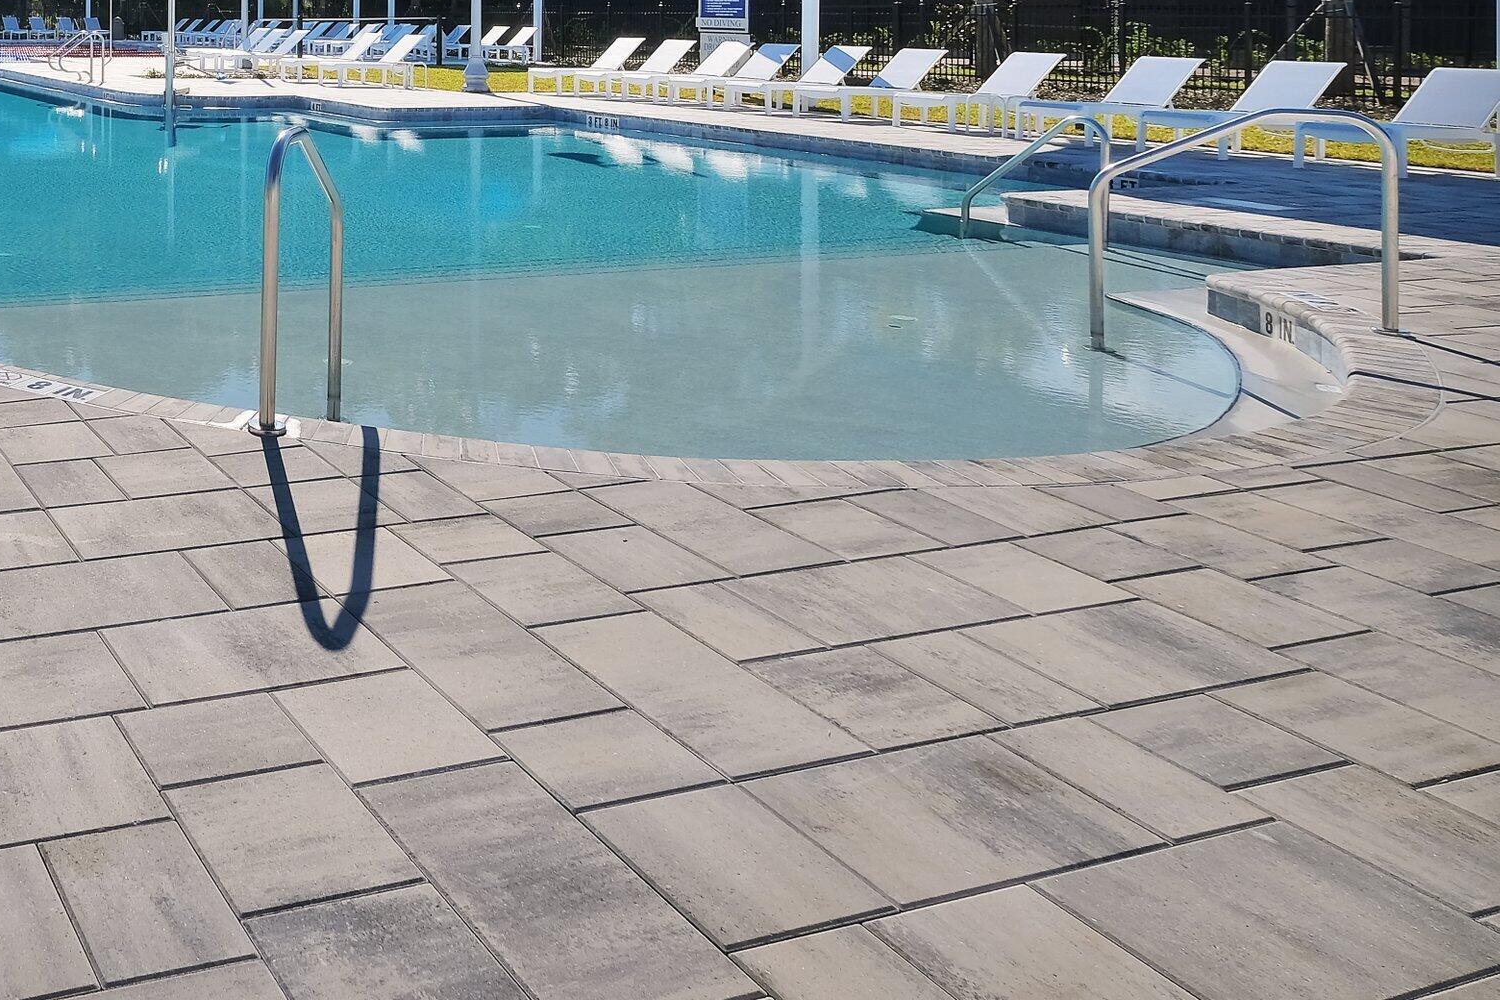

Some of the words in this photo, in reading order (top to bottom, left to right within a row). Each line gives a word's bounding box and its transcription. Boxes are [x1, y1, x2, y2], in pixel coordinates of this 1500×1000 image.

[714, 19, 741, 27] DIVING
[1265, 311, 1273, 335] 8
[1279, 316, 1295, 345] IN.
[26, 381, 53, 390] 8
[53, 386, 94, 401] IN.
